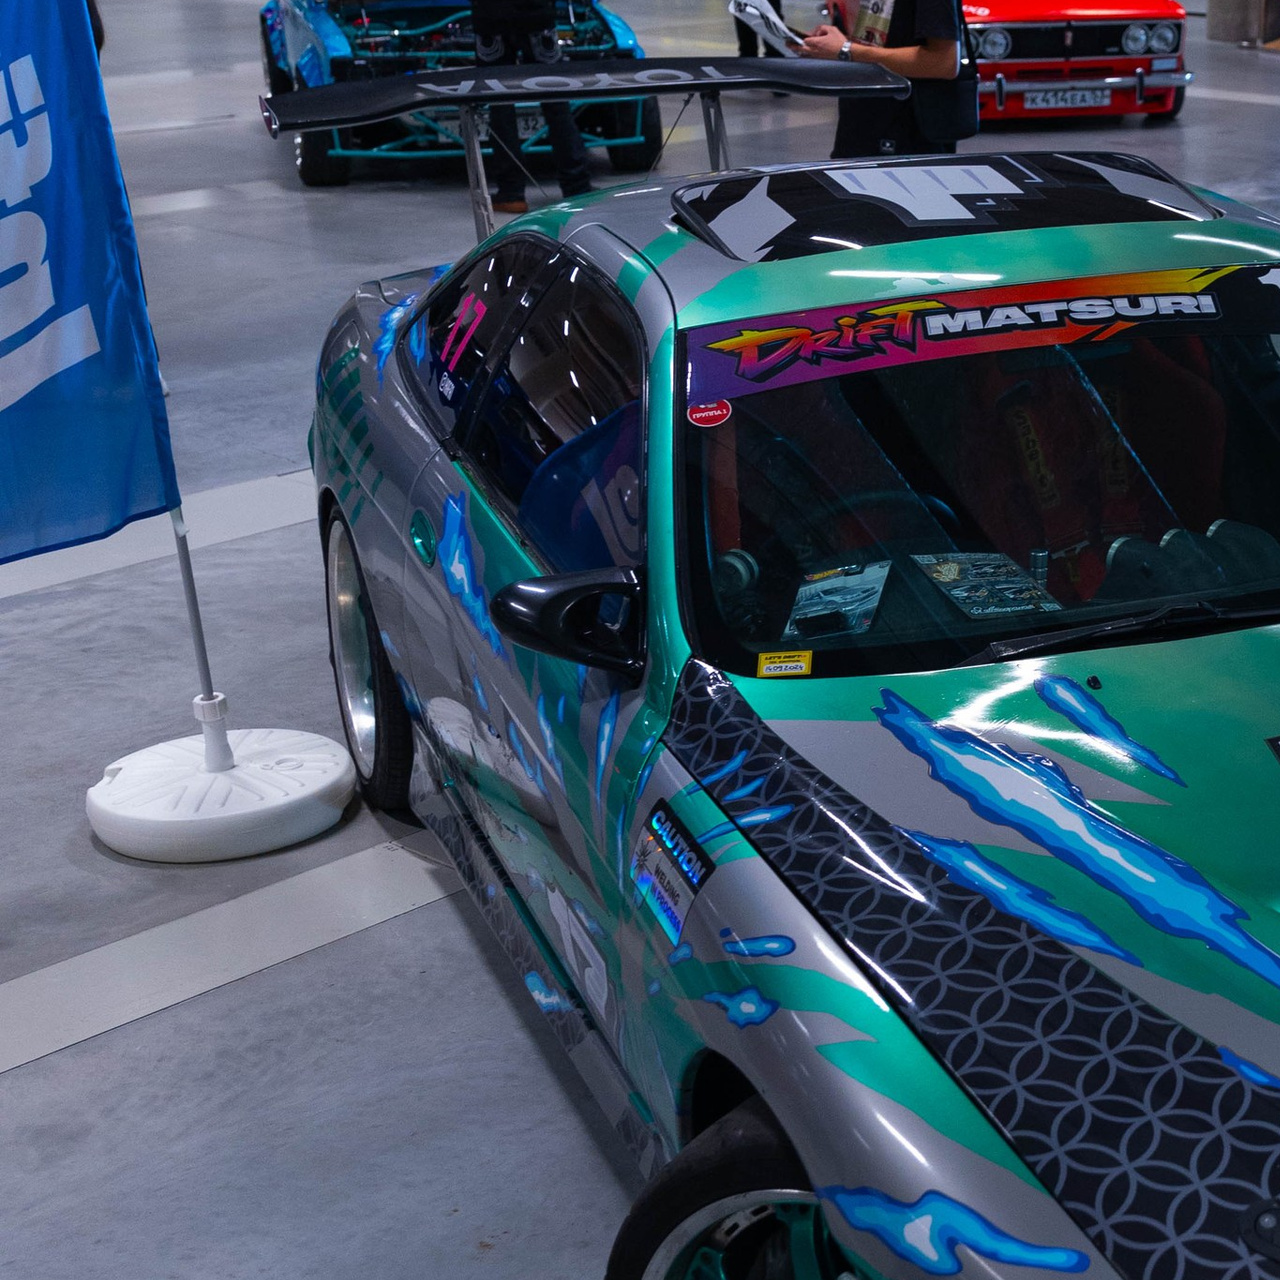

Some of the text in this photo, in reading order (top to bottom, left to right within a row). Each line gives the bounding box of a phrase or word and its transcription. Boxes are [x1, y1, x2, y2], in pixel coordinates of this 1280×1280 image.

[416, 64, 745, 96] TOYOTA
[704, 293, 1218, 382] DRIFT MATSURI
[651, 809, 706, 886] CAUTION
[653, 862, 681, 907] WELDING
